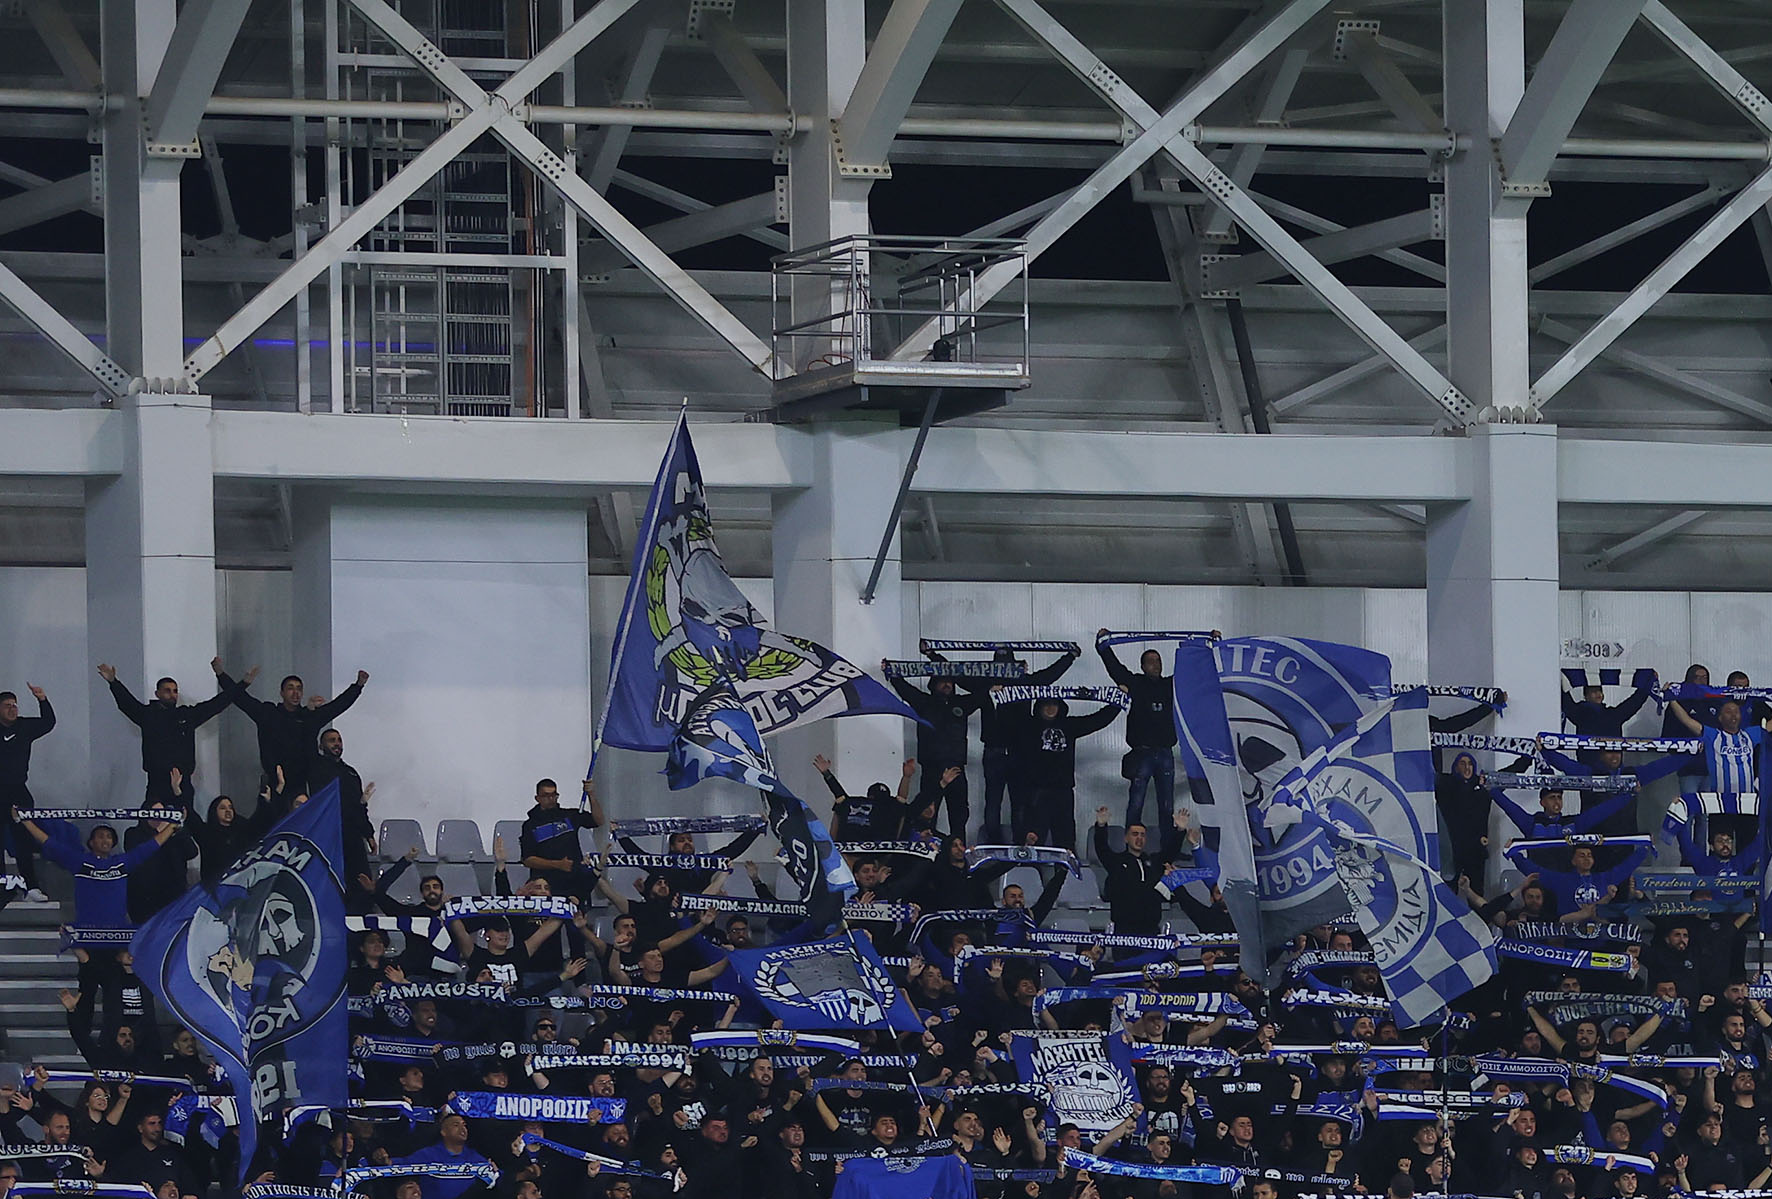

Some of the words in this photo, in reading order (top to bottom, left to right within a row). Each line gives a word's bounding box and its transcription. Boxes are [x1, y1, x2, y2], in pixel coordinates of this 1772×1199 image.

[1392, 684, 1460, 698] MAHTEC
[1259, 848, 1333, 896] 1994
[1500, 941, 1574, 962] ΑΝΟΡΘΩΣΙΣ
[376, 982, 507, 1003] FAMAGUSTA
[592, 984, 651, 998] AXHTEC
[674, 988, 739, 1002] SALONIC
[1140, 994, 1156, 1006] 100
[534, 1054, 622, 1071] MAXHTEC
[641, 1053, 685, 1070] 1994
[1030, 1042, 1108, 1074] MAXHTEC
[950, 1081, 1054, 1108] MAGUSTA
[496, 1095, 591, 1121] ΑΝΟΡΘΩΣΙΣ
